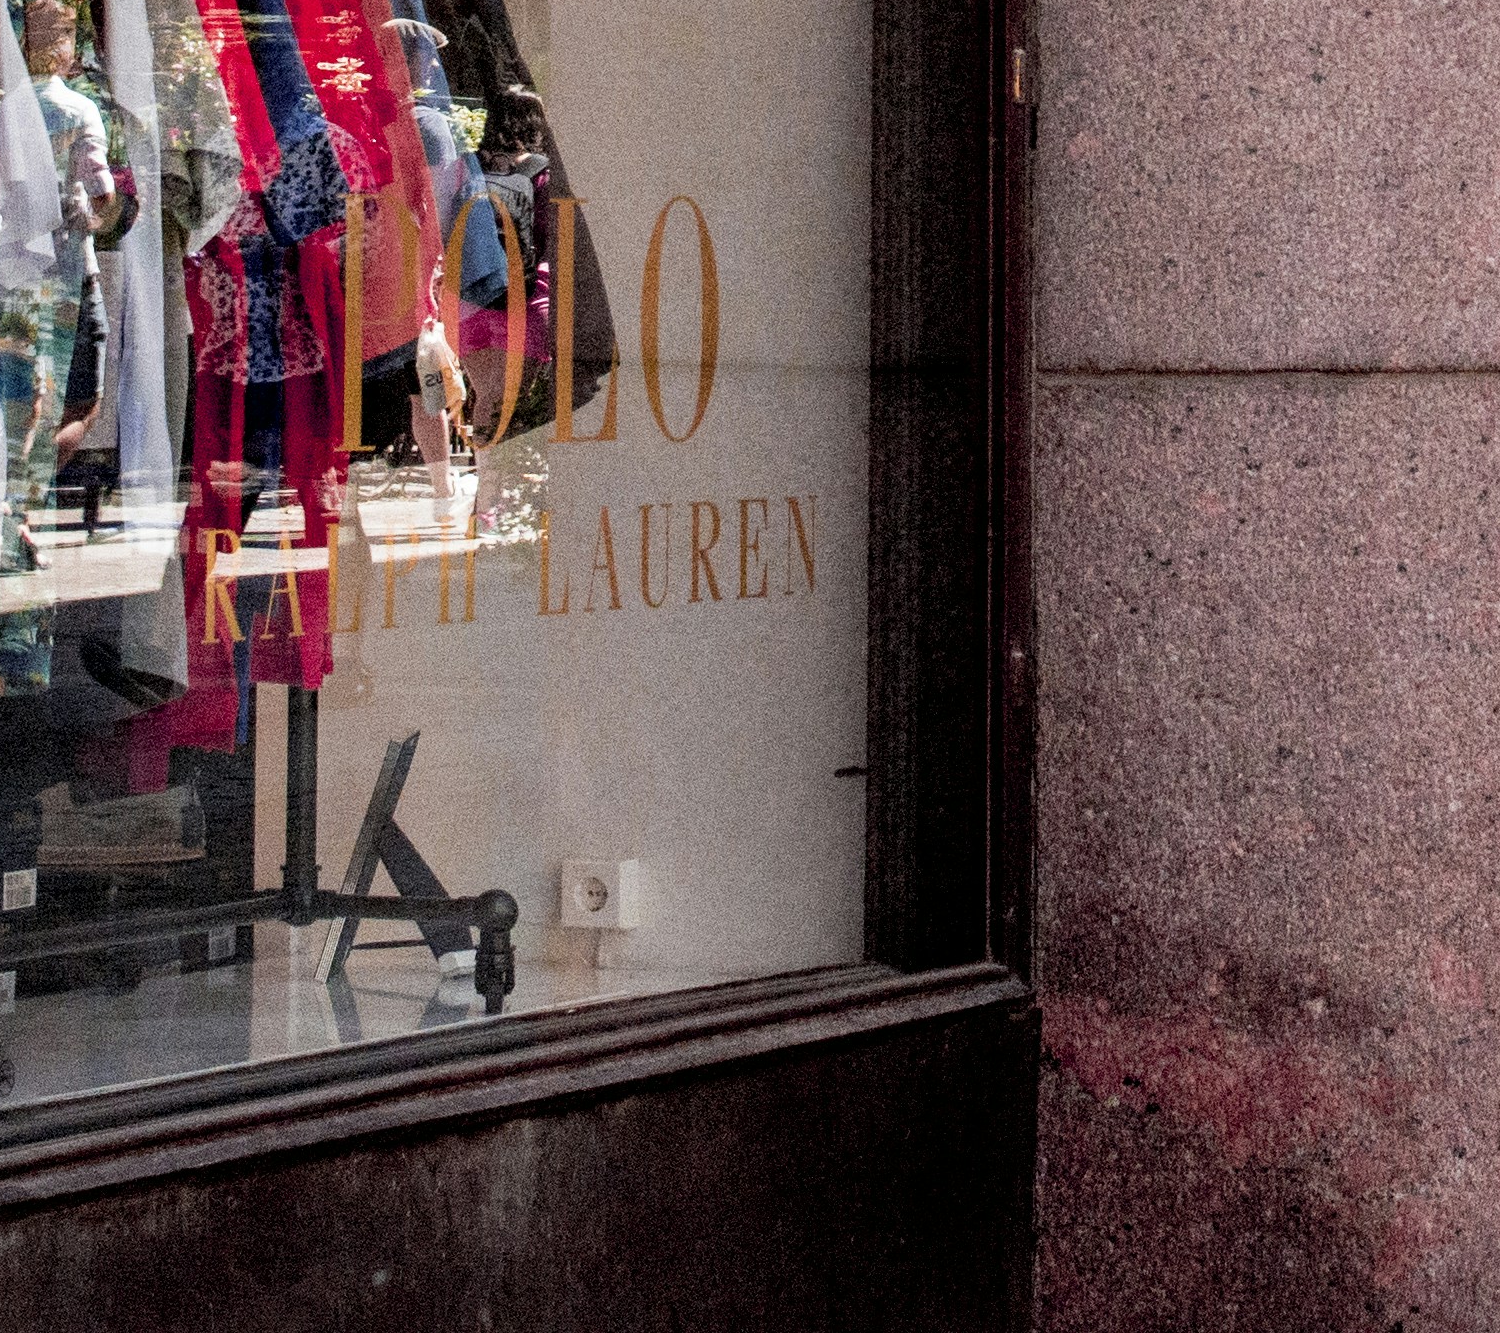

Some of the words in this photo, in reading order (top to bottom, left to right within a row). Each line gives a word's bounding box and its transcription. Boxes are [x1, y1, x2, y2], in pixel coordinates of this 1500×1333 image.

[335, 193, 720, 454] POLO
[202, 513, 478, 645] RALPH
[537, 495, 820, 619] LAUREN
